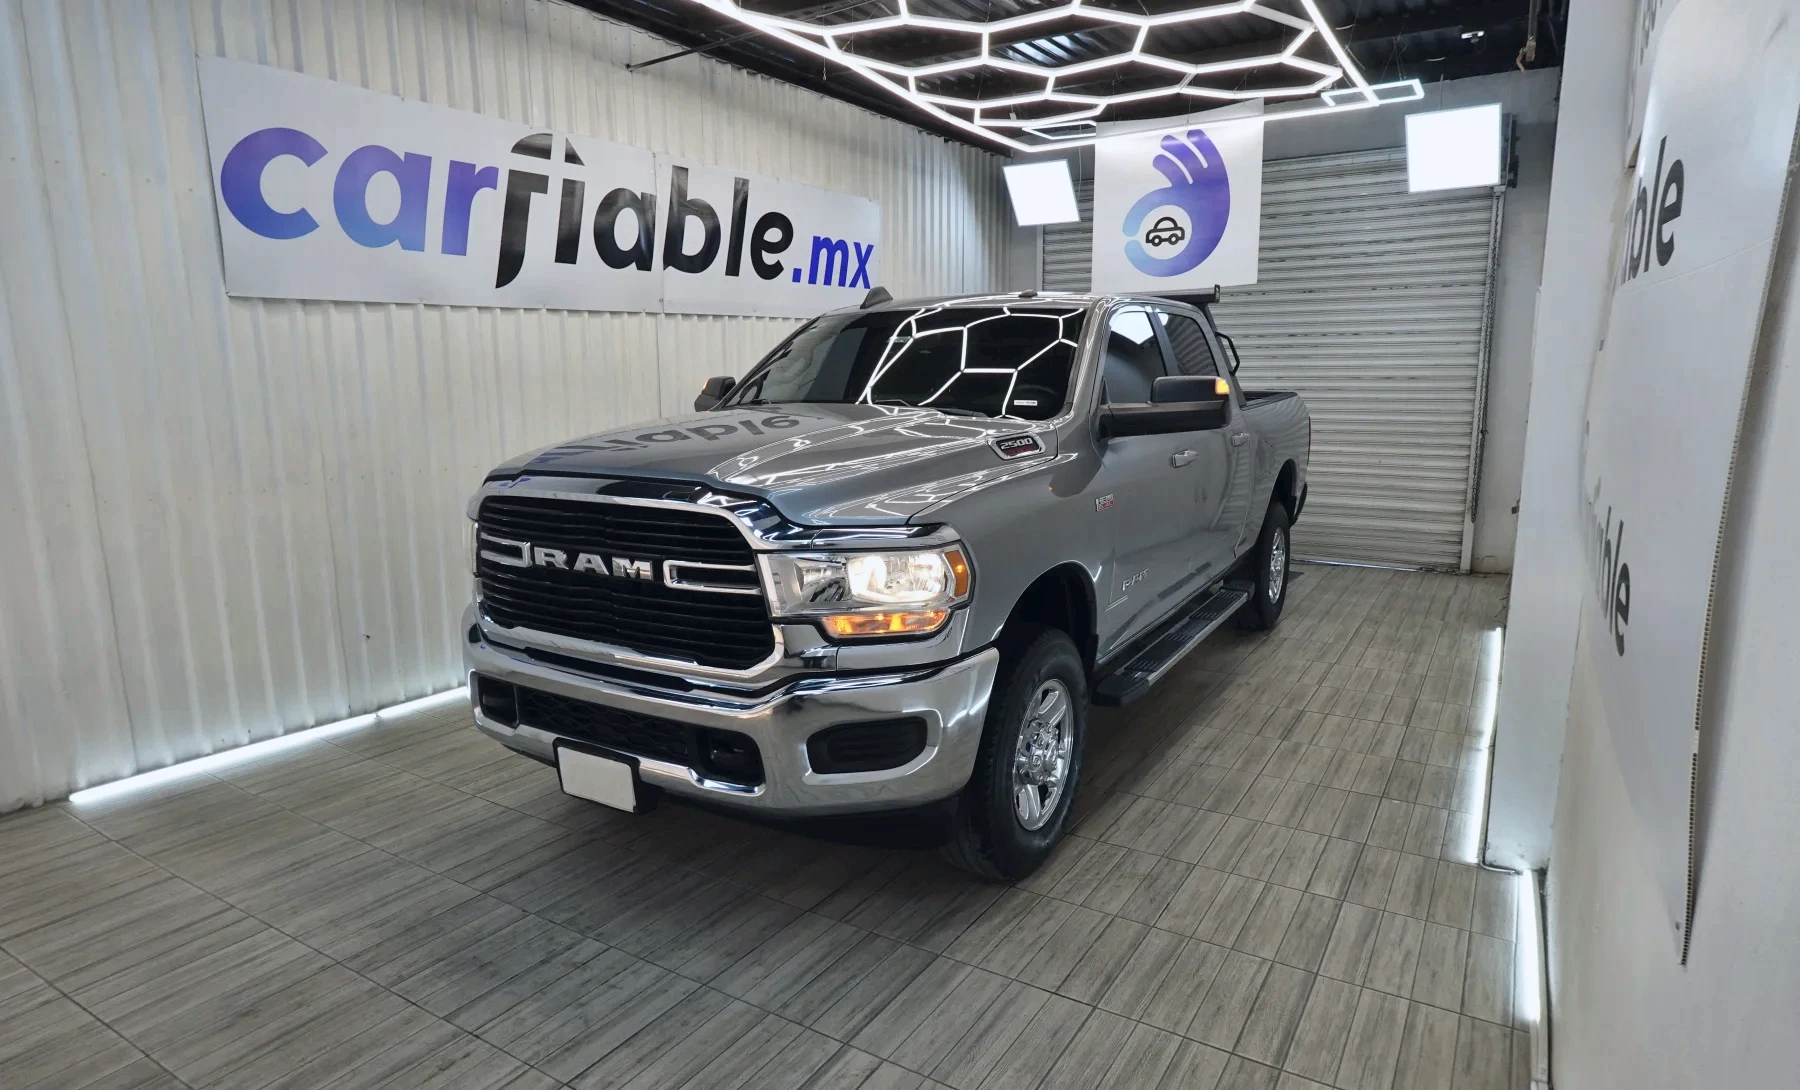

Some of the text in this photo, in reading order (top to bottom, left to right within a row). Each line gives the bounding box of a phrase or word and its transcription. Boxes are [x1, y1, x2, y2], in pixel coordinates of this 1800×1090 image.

[220, 127, 875, 290] carfiable.mx
[1000, 437, 1034, 450] 2500
[533, 546, 654, 581] RAM
